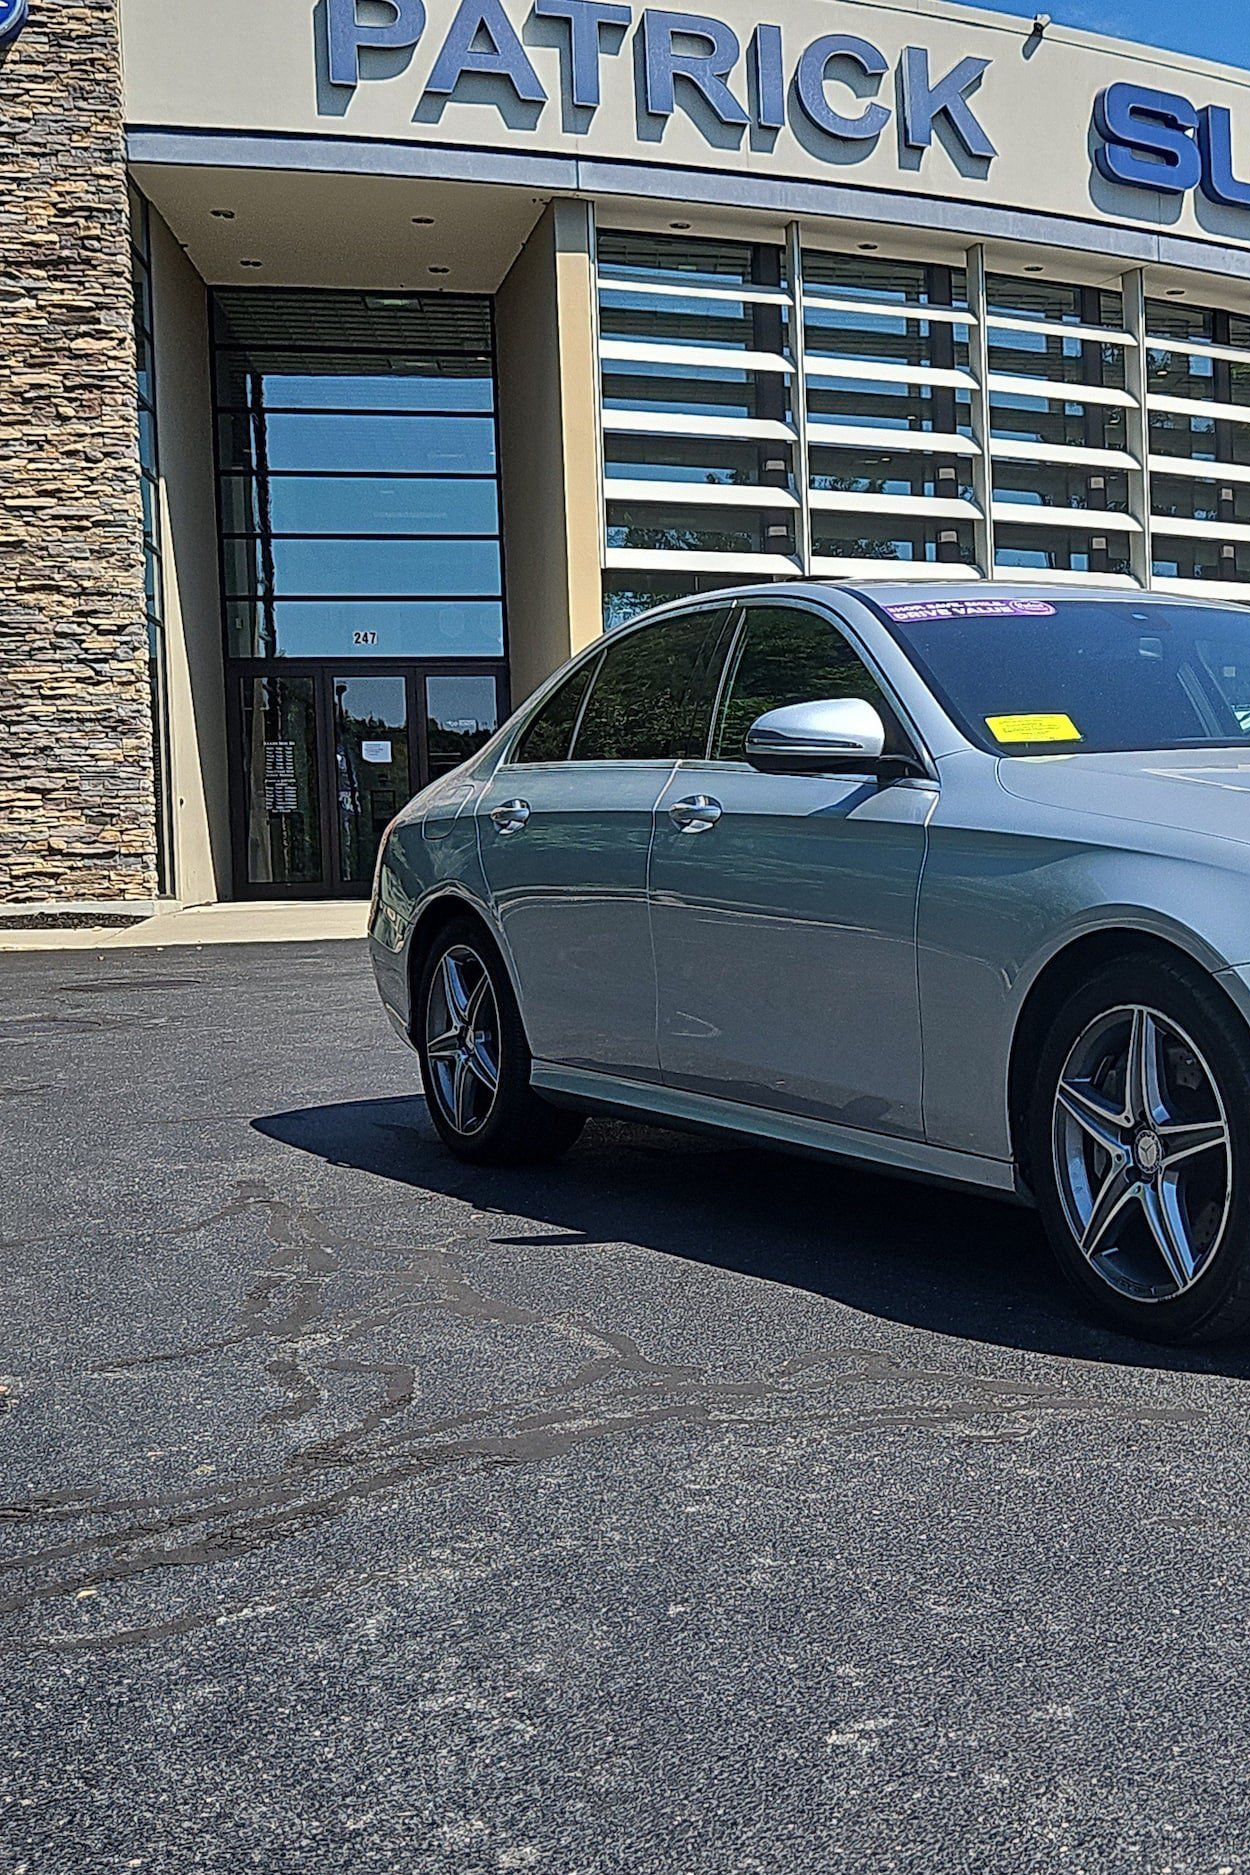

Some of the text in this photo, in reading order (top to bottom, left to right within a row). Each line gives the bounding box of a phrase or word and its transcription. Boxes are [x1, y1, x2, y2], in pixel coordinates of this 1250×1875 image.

[328, 0, 999, 158] PATRICK
[892, 608, 952, 620] DRIVE
[952, 606, 1015, 616] VALUE
[353, 631, 377, 645] 247
